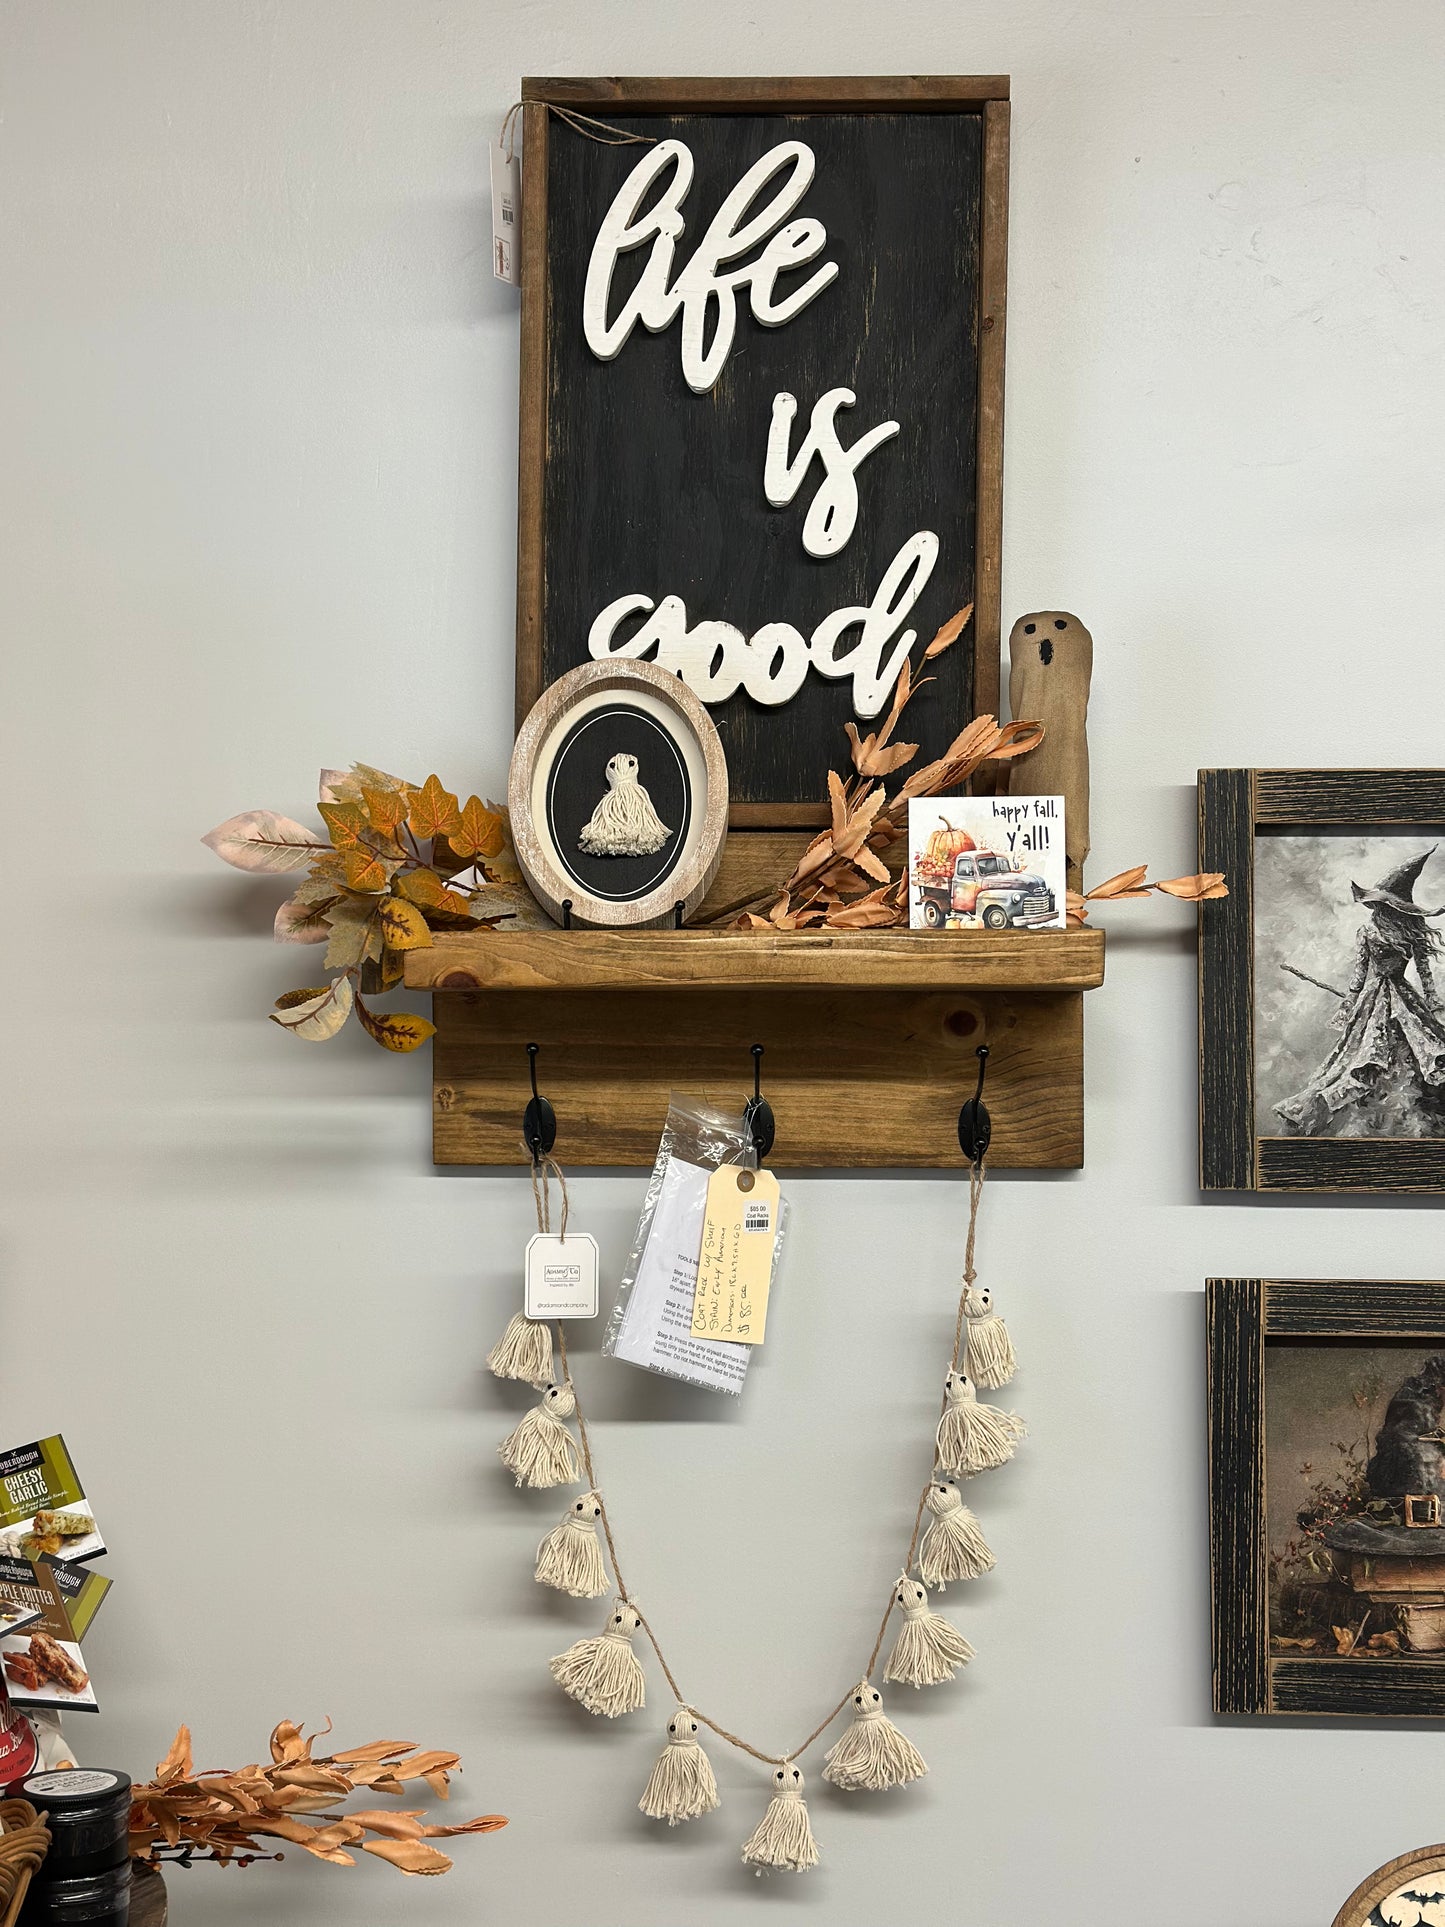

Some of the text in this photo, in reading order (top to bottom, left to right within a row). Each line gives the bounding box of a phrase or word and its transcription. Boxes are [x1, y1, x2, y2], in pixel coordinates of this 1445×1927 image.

[583, 139, 839, 394] life
[763, 387, 900, 559] is
[992, 799, 1058, 823] happy fall,
[1006, 824, 1050, 852] y'all!
[4, 1466, 43, 1492] CHEESY
[9, 1480, 48, 1505] GARLIC
[52, 1567, 81, 1588] RDOUGH
[19, 1585, 56, 1606] FRITTER
